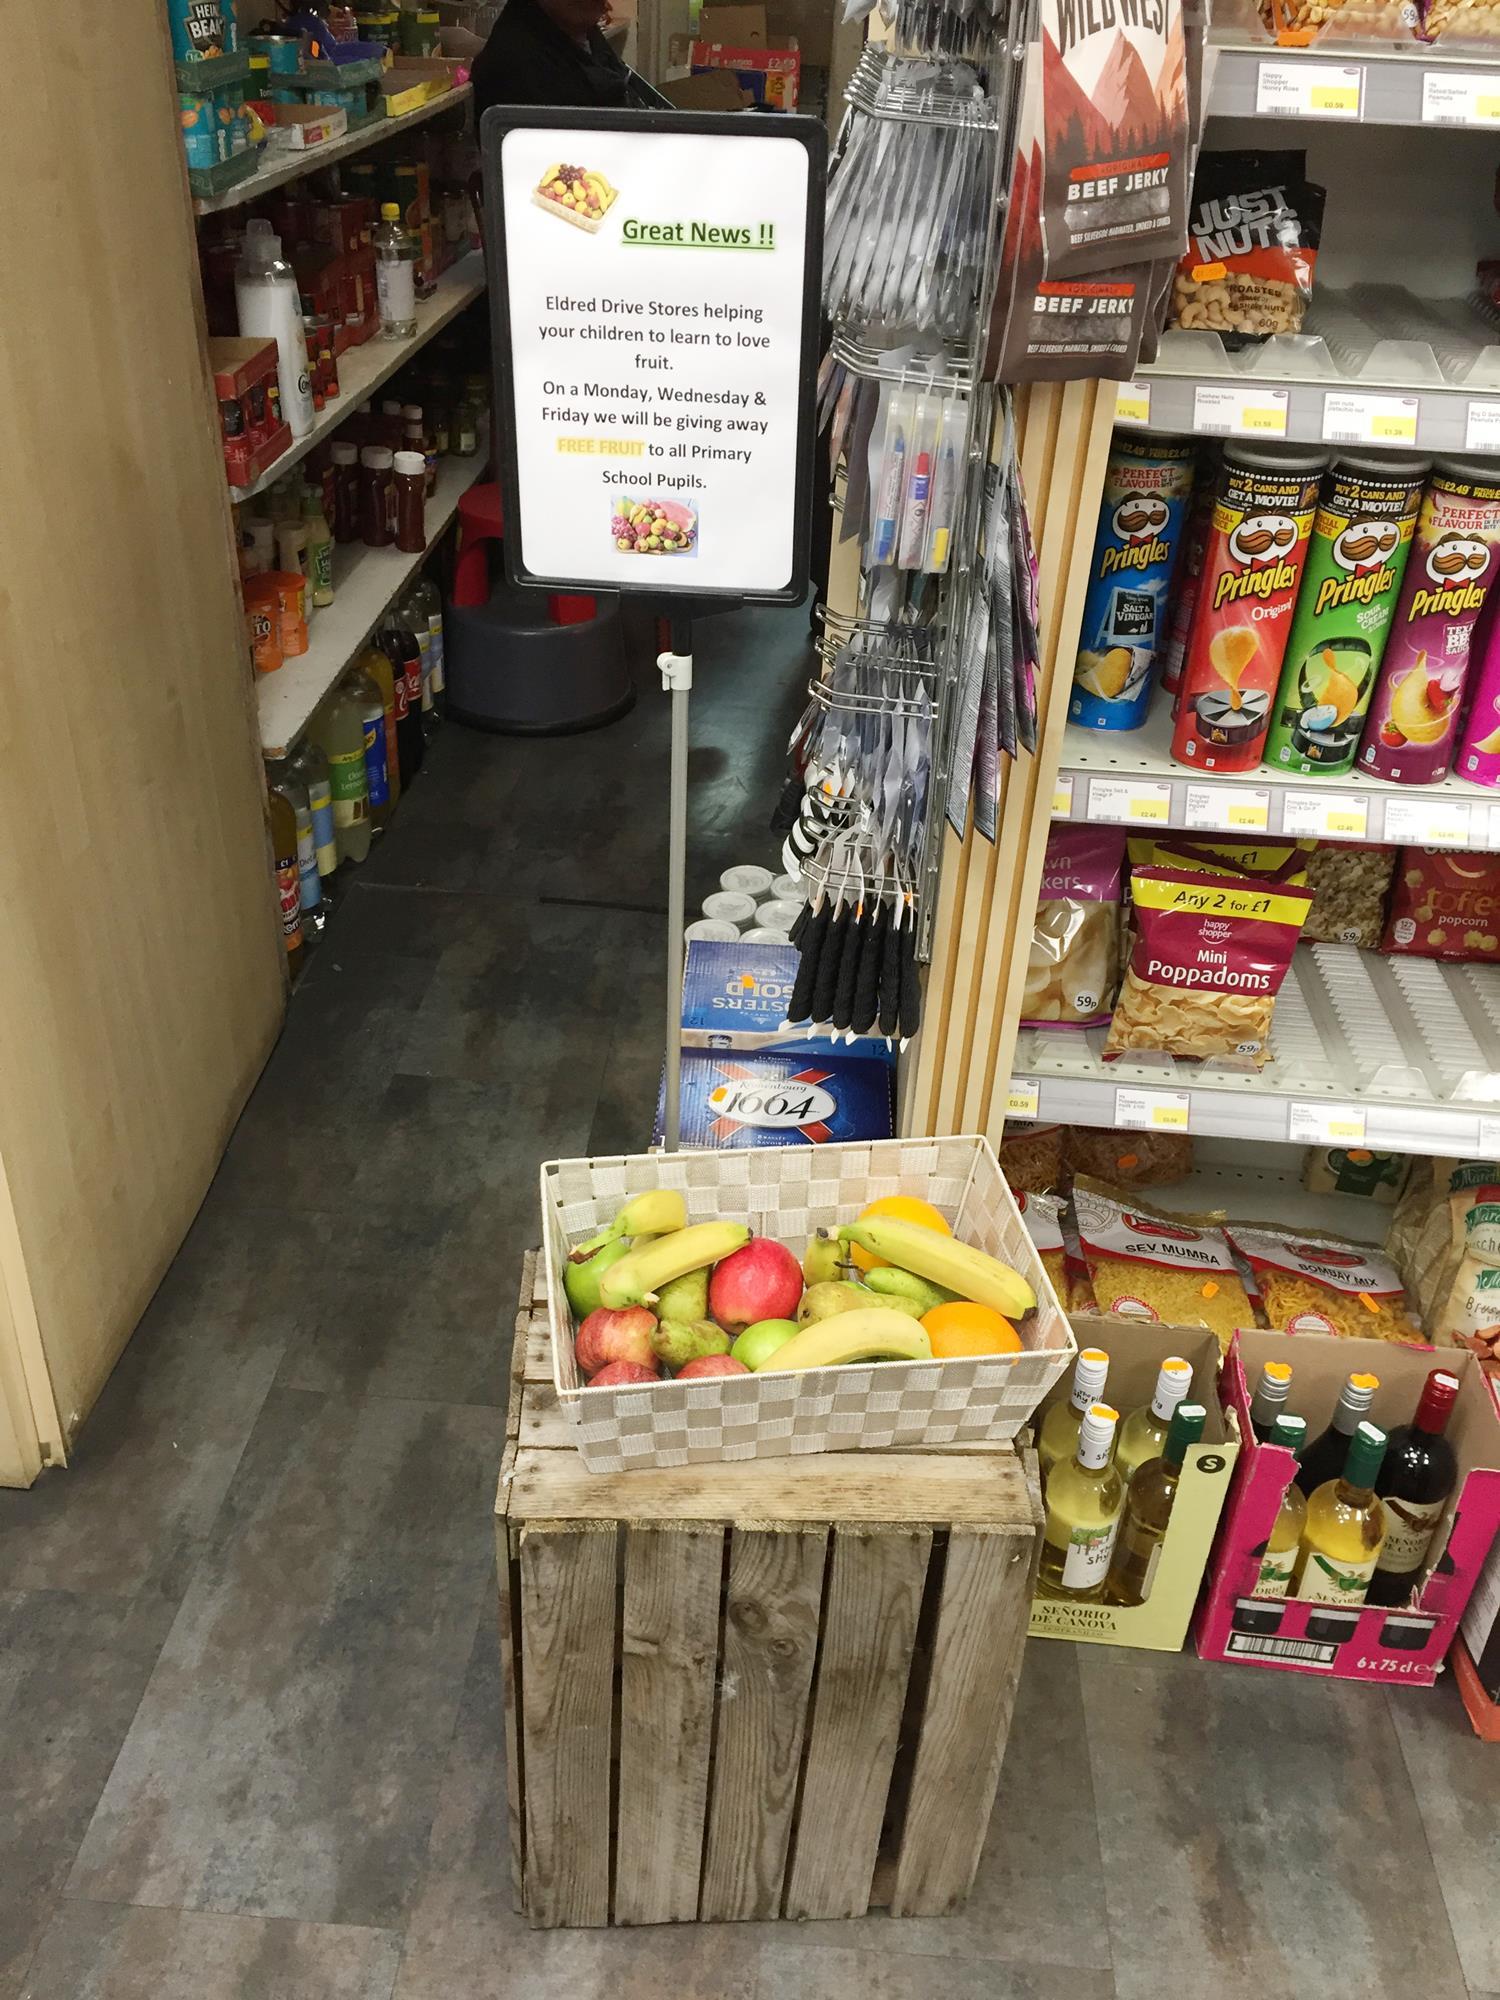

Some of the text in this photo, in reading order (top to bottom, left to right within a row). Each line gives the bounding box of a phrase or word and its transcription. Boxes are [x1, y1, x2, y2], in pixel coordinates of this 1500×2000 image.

[1057, 0, 1169, 57] WILD WEST
[1068, 168, 1168, 200] BEEF JERKY
[1192, 185, 1288, 235] JUST
[622, 219, 774, 245] Great News !!
[1070, 234, 1083, 244] BEEF
[1196, 208, 1301, 263] NUTS
[546, 296, 763, 323] Eldred Drive Stores helping
[1034, 296, 1134, 314] BEEF JERKY
[539, 325, 771, 348] your children to learn to love
[635, 354, 674, 370] fruit.
[543, 381, 766, 408] On a Monday, Wednesday &
[542, 407, 768, 435] Friday we will be giving away
[557, 439, 752, 464] FREE FRUIT to all Primary
[602, 470, 707, 490] School Pupils.
[1122, 468, 1176, 479] PERFECT
[1114, 478, 1161, 488] FLAVOUR
[1244, 479, 1252, 491] 2
[1254, 484, 1277, 494] CANS
[1278, 485, 1299, 494] AND
[1228, 489, 1245, 498] GET
[1245, 493, 1253, 502] A
[1254, 495, 1299, 506] MOVIE!
[1350, 486, 1360, 497] 2
[1361, 490, 1385, 499] CANS
[1385, 491, 1405, 500] AND
[1333, 495, 1351, 507] GET
[1351, 499, 1359, 508] A
[1361, 501, 1404, 512] MOVIE!
[1442, 507, 1500, 520] PERFECT
[1432, 517, 1482, 529] FLAVOUR
[1100, 537, 1170, 578] Pringles
[1214, 560, 1297, 609] Pringles
[1314, 564, 1396, 616] Pringles
[1122, 603, 1144, 613] SALT
[1252, 598, 1292, 621] Original
[1408, 582, 1486, 622] Pringles
[1357, 604, 1381, 623] SOUR
[1447, 624, 1474, 636] TEXA
[1447, 633, 1470, 647] BB
[1240, 851, 1257, 865] £1
[1173, 891, 1271, 913] Any 2 for £1
[1204, 919, 1230, 931] happy
[1438, 915, 1488, 927] popcorn
[1198, 927, 1232, 939] shopper
[1342, 932, 1359, 941] 59p
[1197, 950, 1227, 964] Mini
[1148, 960, 1270, 989] Poppadoms
[712, 998, 791, 1011] OSTER'S
[1076, 995, 1097, 1008] 59p
[1237, 1043, 1259, 1053] 59p
[726, 1090, 820, 1119] 1664
[1125, 1243, 1220, 1265] SEV MUMRA
[1298, 1263, 1378, 1287] BOMBAY MIX
[1042, 1605, 1111, 1620] SEÑORIO
[1032, 1614, 1116, 1630] DE CANOVA
[1357, 1657, 1412, 1673] 6 x 75 cl
